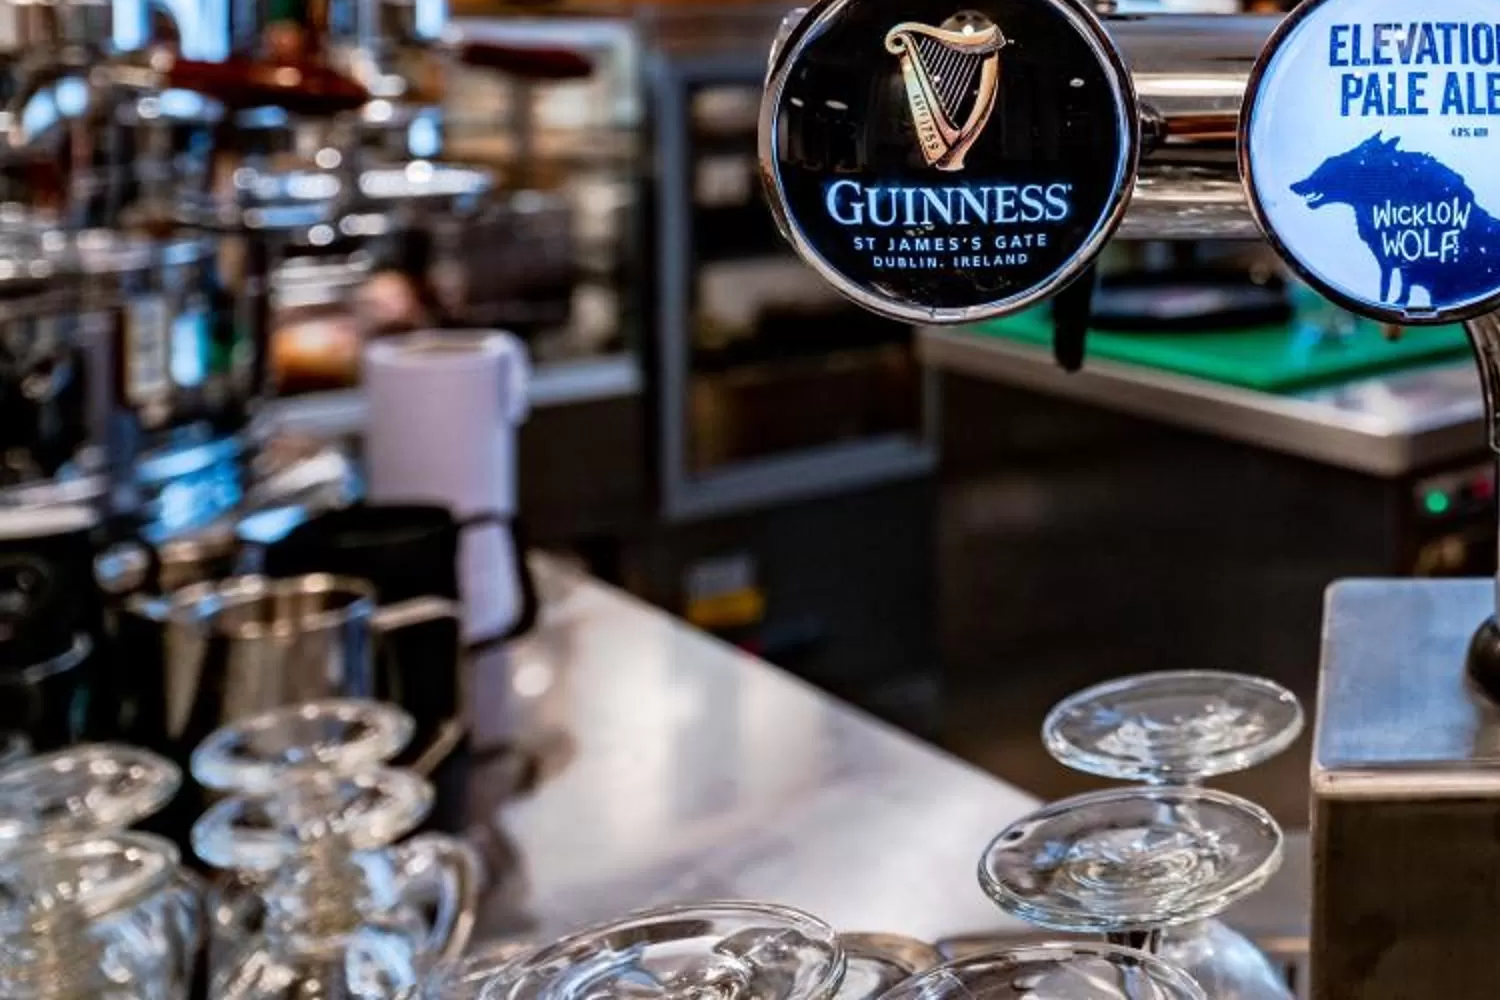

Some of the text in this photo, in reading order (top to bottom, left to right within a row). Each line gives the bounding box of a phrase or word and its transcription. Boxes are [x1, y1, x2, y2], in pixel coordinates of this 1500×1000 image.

[1340, 72, 1429, 117] PALE
[826, 179, 1070, 226] GUINNESS
[853, 233, 1047, 251] ST JAMES'S GATE
[953, 253, 1029, 268] IRELAND
